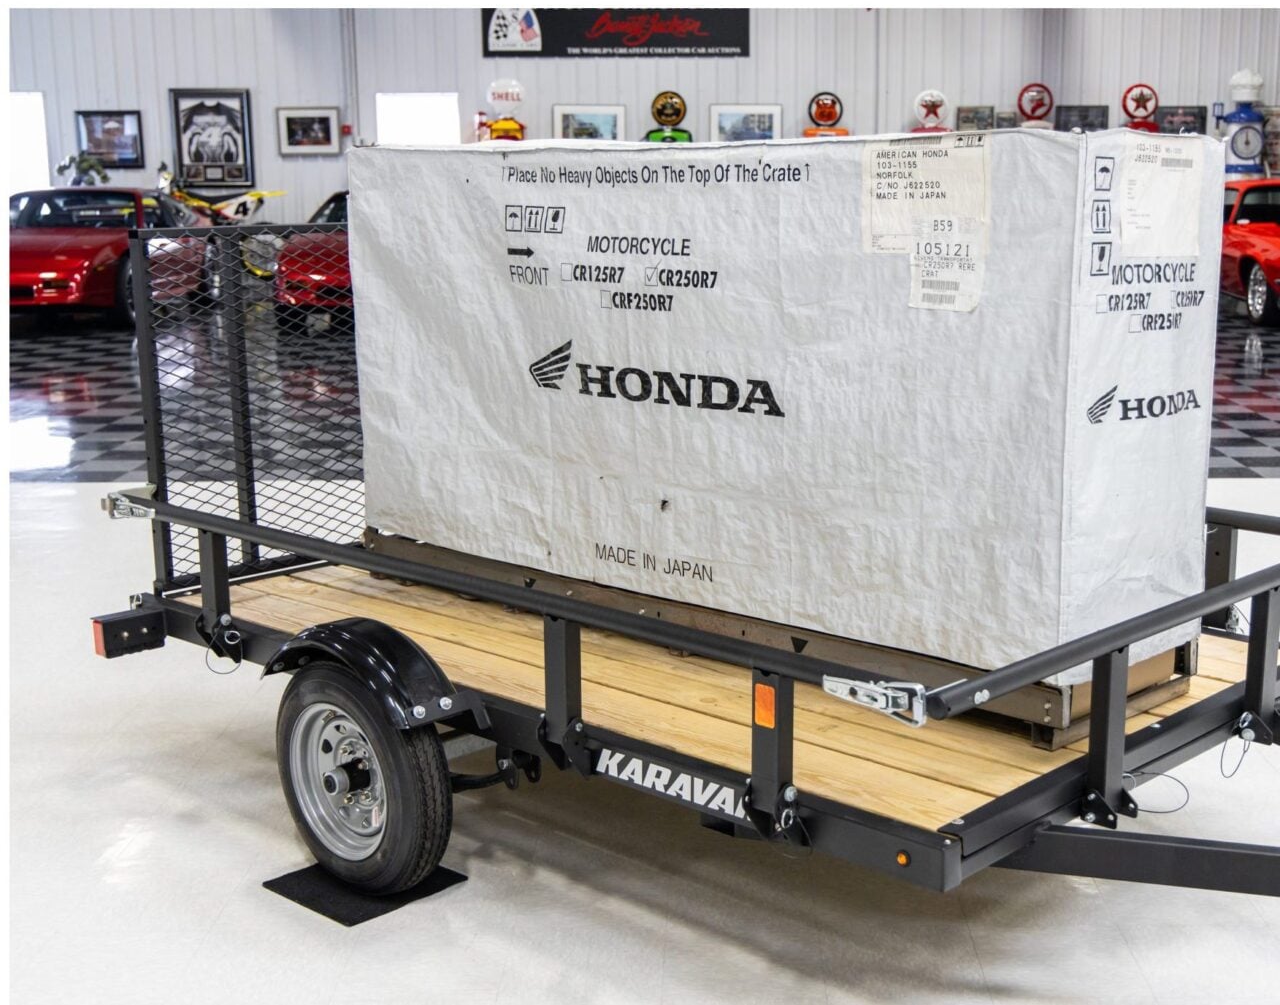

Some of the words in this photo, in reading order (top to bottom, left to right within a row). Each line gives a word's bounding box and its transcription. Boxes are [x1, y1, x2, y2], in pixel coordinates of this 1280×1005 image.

[567, 47, 581, 55] THE
[491, 91, 523, 102] SHELL
[876, 150, 918, 159] AMERICAN
[922, 149, 949, 158] HONDA
[876, 171, 913, 179] NORFOLK
[877, 161, 918, 169] 103-1155
[507, 166, 537, 184] Place
[540, 166, 556, 184] No
[558, 166, 592, 188] Heavy
[595, 166, 638, 188] Objects
[641, 165, 659, 184] On
[662, 165, 685, 183] The
[688, 165, 711, 187] Top
[714, 164, 730, 183] Of
[734, 164, 758, 183] The
[762, 163, 801, 182] Crate
[875, 192, 898, 200] MADE
[920, 191, 947, 199] JAPAN
[234, 201, 250, 216] 4
[933, 219, 953, 232] B59
[586, 236, 691, 256] MOTORCYCLE
[916, 242, 970, 258] 105121
[509, 264, 549, 286] FRONT
[573, 264, 625, 284] CR125R7
[658, 269, 718, 288] CR250R7
[1111, 263, 1196, 285] MOTORCYCLE
[612, 291, 674, 311] CRF250R7
[1108, 292, 1152, 312] CR125R7
[576, 362, 785, 417] HONDA
[1118, 388, 1201, 421] HONDA
[595, 542, 636, 567] MADE
[642, 552, 656, 571] IN
[663, 558, 713, 582] JAPAN
